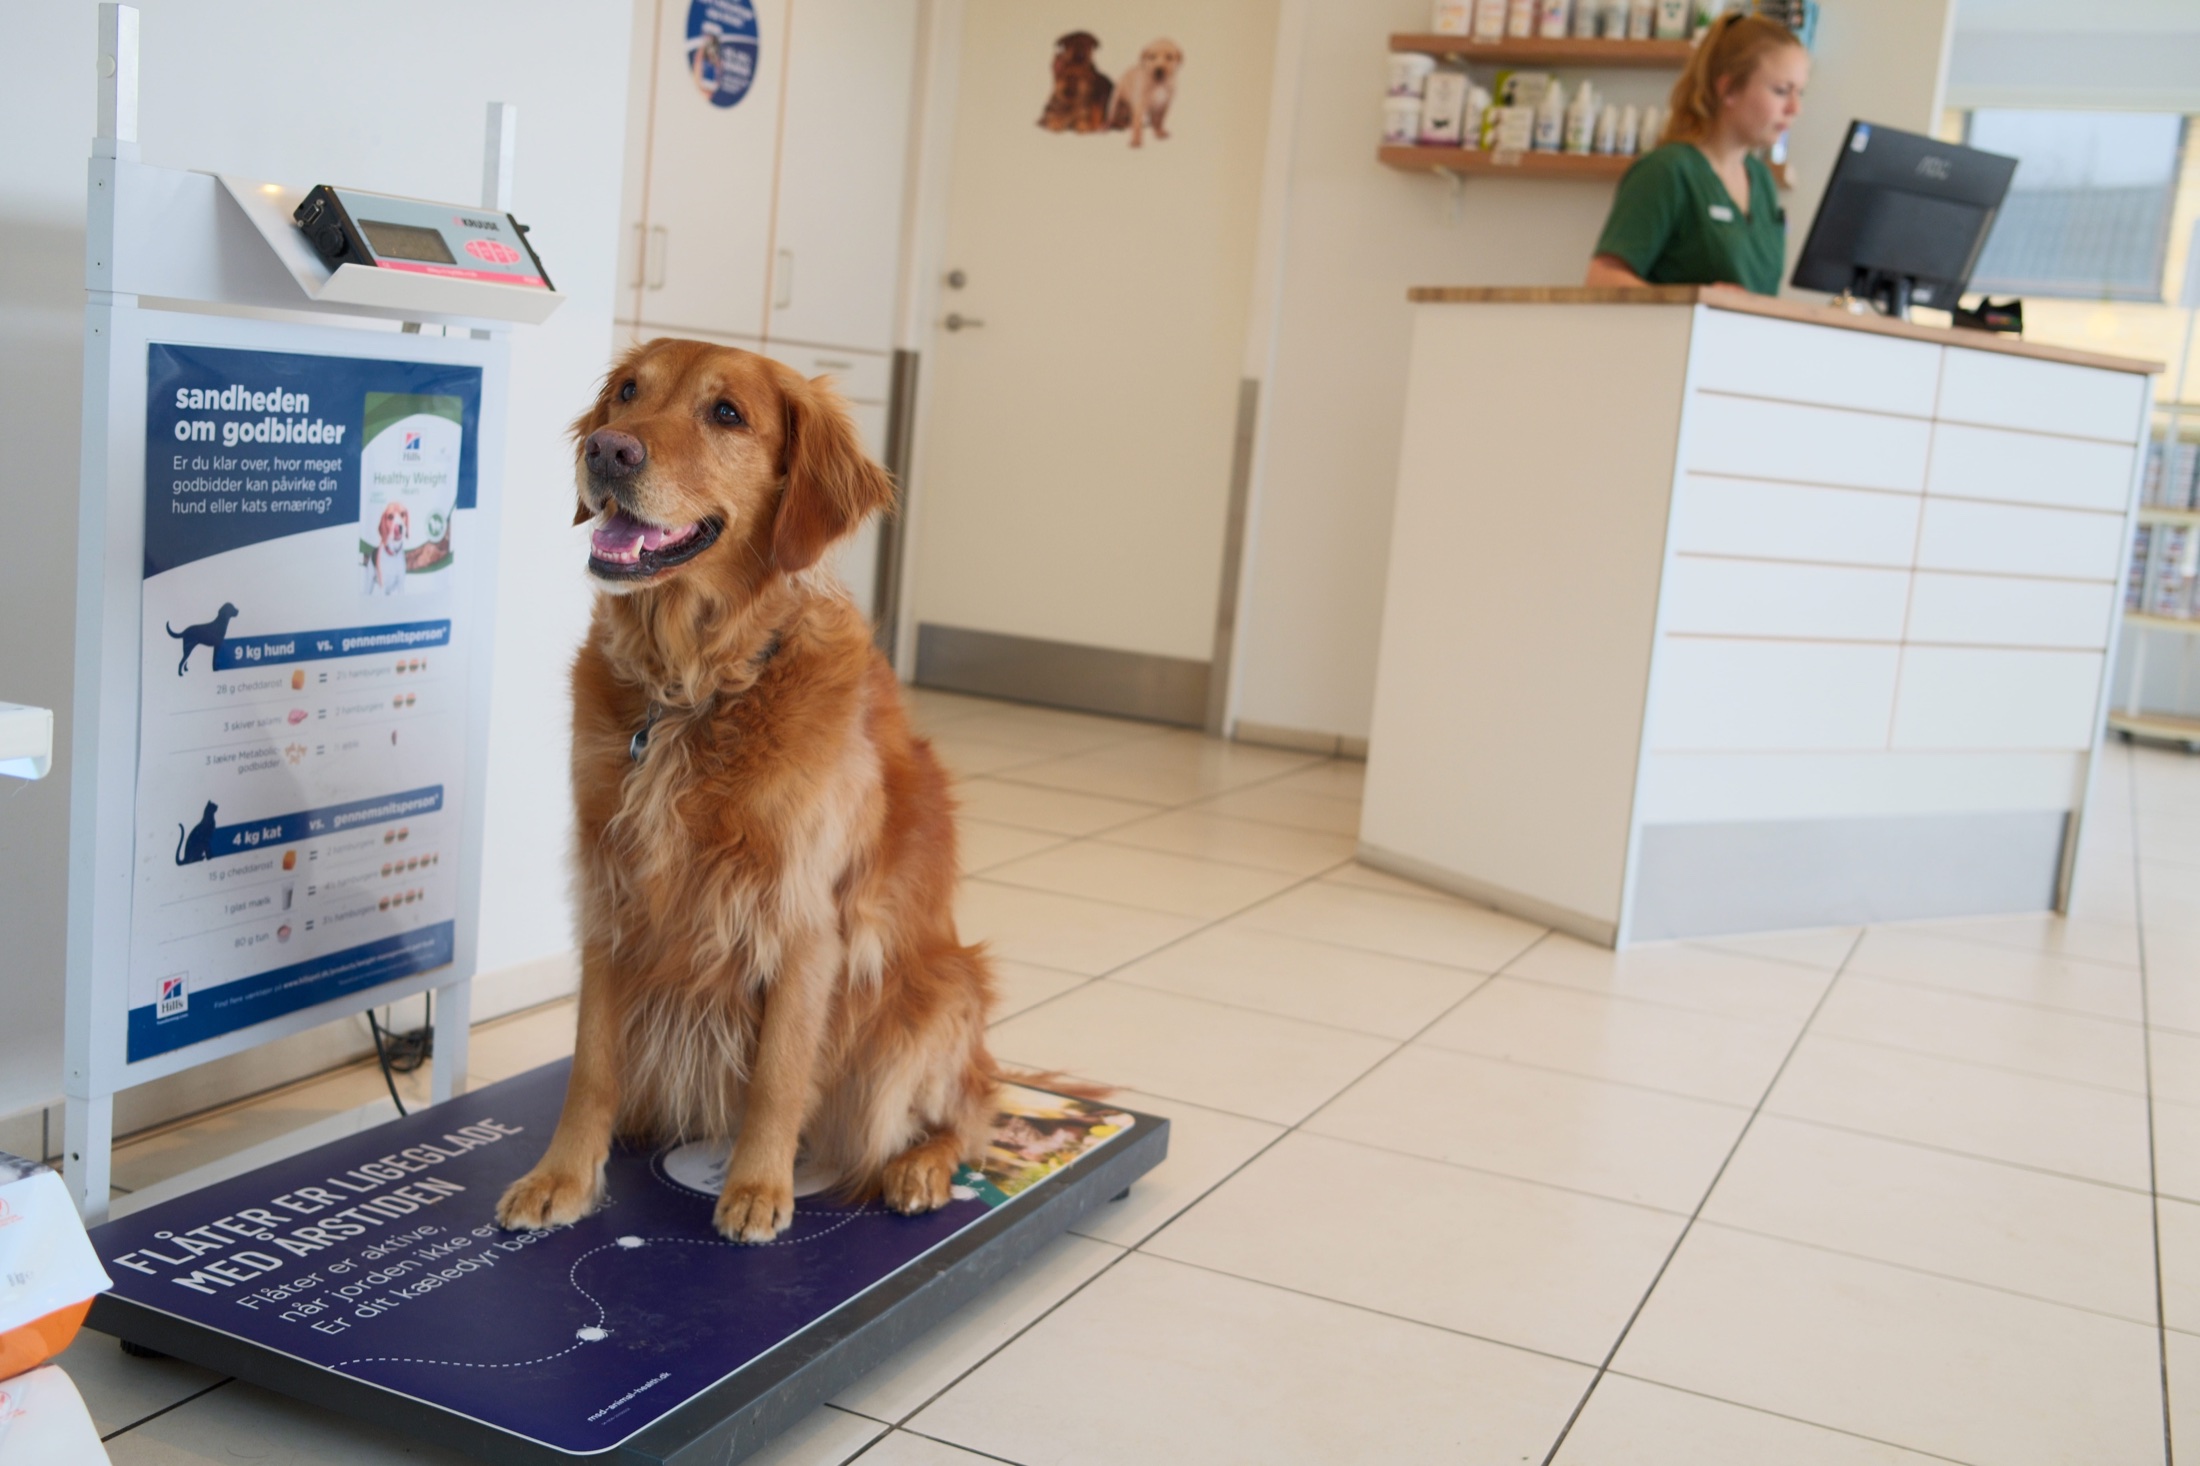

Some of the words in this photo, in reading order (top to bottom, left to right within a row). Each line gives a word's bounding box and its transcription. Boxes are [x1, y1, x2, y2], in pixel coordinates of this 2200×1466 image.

[175, 384, 310, 414] sandheden
[174, 420, 216, 441] om
[223, 416, 346, 447] godbidder
[173, 455, 188, 470] Er
[192, 455, 209, 470] du
[213, 455, 238, 471] klar
[240, 459, 271, 472] over,
[274, 456, 301, 471] hvor
[304, 457, 343, 474] meget
[172, 477, 243, 495] godbidder
[246, 477, 269, 492] kan
[271, 475, 317, 494] påvirke
[318, 477, 338, 492] din
[373, 472, 411, 487] Healthy
[413, 472, 447, 488] Weight
[172, 499, 207, 514] hund
[210, 498, 238, 514] eller
[241, 498, 268, 513] kats
[270, 497, 333, 514] ernæring?
[234, 645, 244, 660] 9
[246, 644, 262, 661] kg
[264, 640, 296, 657] hund
[316, 639, 334, 652] vs.
[216, 684, 228, 695] 28
[229, 686, 236, 695] g
[237, 679, 283, 693] cheddarost
[231, 719, 255, 731] skiver
[238, 759, 281, 775] godbidder
[232, 832, 242, 846] 4
[244, 830, 260, 846] kg
[262, 825, 282, 841] kat
[309, 818, 325, 831] vs.
[208, 871, 218, 882] 15
[219, 871, 226, 880] g
[227, 860, 274, 878] cheddarost
[247, 936, 254, 946] g
[256, 932, 270, 943] tun
[112, 1208, 293, 1275] FLÅTER
[270, 1186, 348, 1215] ER
[326, 1117, 525, 1193] LIGEGLADE
[171, 1250, 284, 1295] MED
[255, 1176, 467, 1258] ÅRSTIDEN
[235, 1272, 325, 1310] Flåter
[328, 1257, 359, 1275] er
[360, 1224, 449, 1261] aktive,
[278, 1297, 330, 1323] når
[324, 1258, 424, 1304] jorden
[411, 1236, 473, 1262] ikke
[471, 1222, 500, 1238] er
[310, 1317, 353, 1336] Er
[354, 1296, 401, 1319] dit
[388, 1248, 501, 1300] kæledyr
